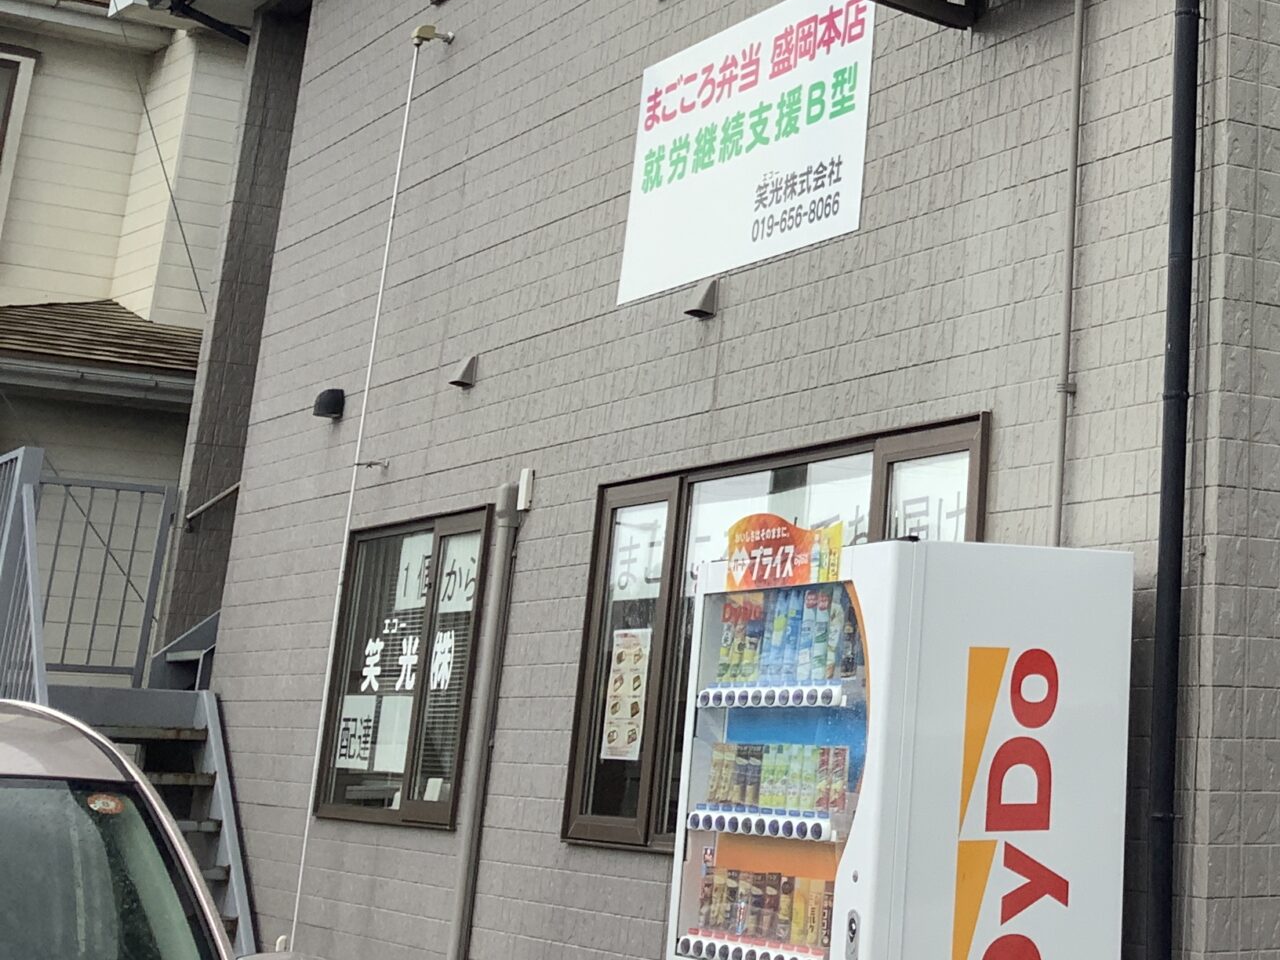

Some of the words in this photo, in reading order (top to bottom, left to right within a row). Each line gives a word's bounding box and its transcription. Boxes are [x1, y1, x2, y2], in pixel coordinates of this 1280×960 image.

[644, 41, 762, 132] まごころ弁当
[640, 61, 858, 193] 就労継続支援B型
[751, 191, 840, 243] 019-656-8066
[754, 154, 843, 212] 笑光株式会社
[337, 714, 372, 762] 配達
[981, 648, 1069, 960] yDo
